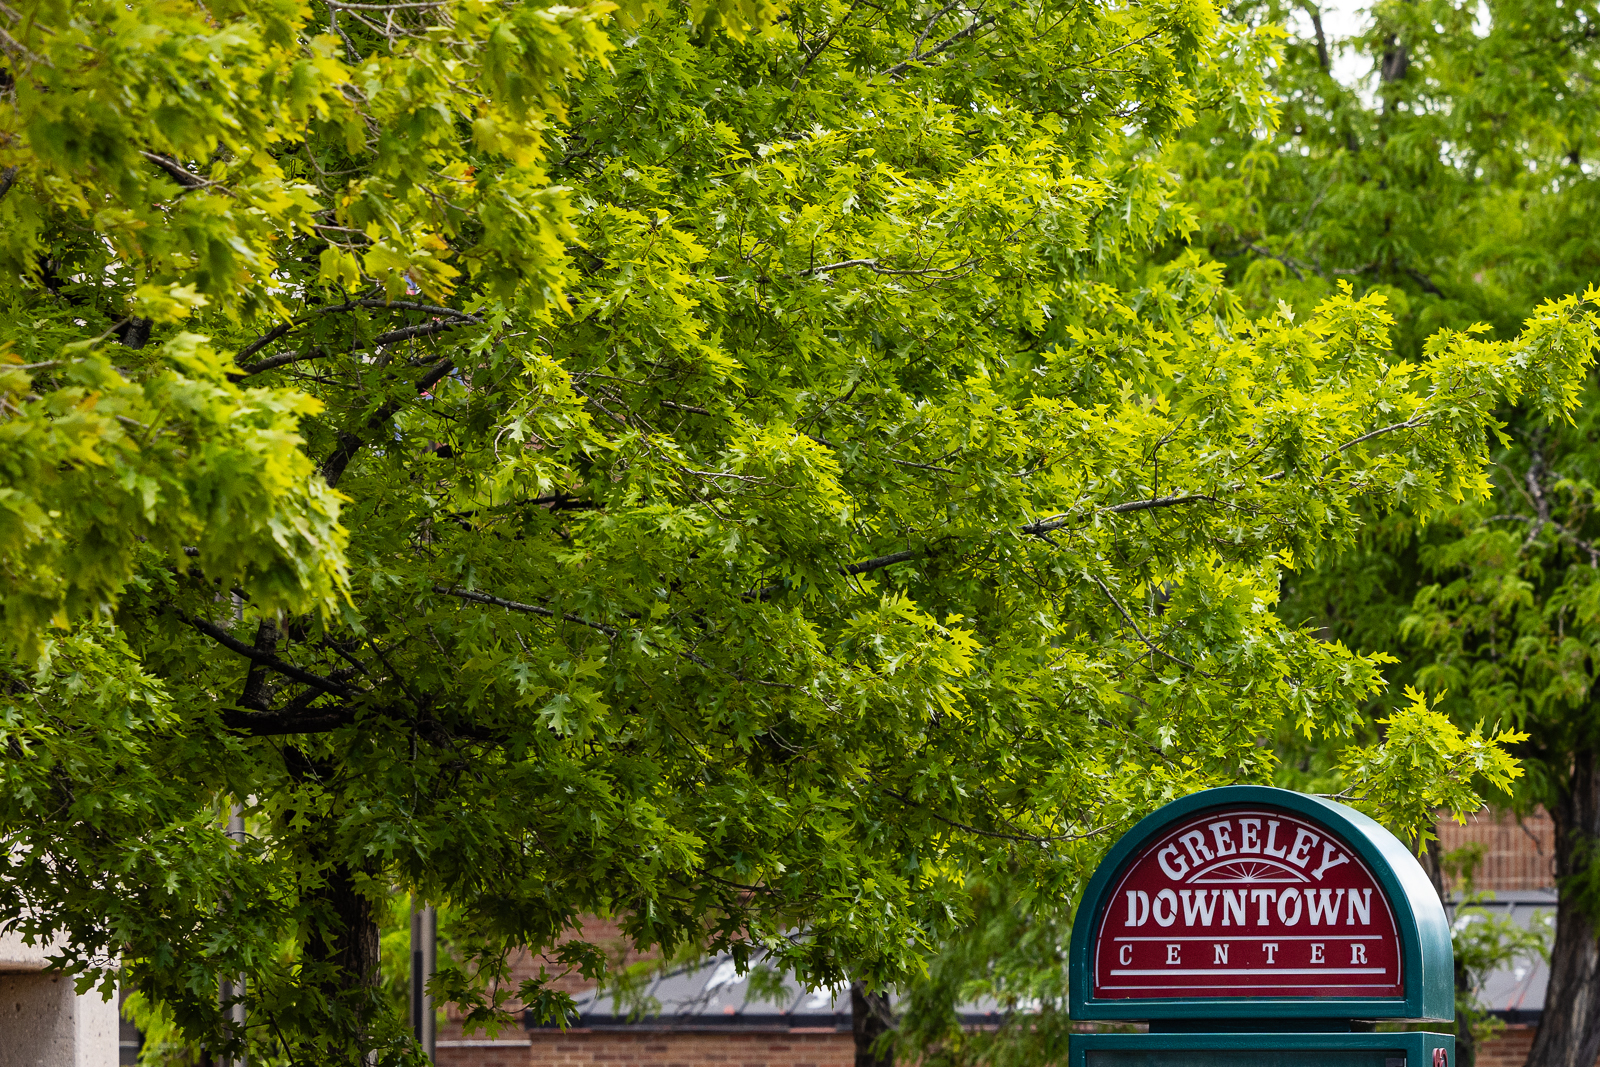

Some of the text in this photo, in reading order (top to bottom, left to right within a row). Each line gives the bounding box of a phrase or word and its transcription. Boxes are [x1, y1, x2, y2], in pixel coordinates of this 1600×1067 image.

[1157, 818, 1350, 881] GREELEY
[1124, 886, 1372, 927] DOWNTOWN
[1119, 943, 1368, 966] CENTER
